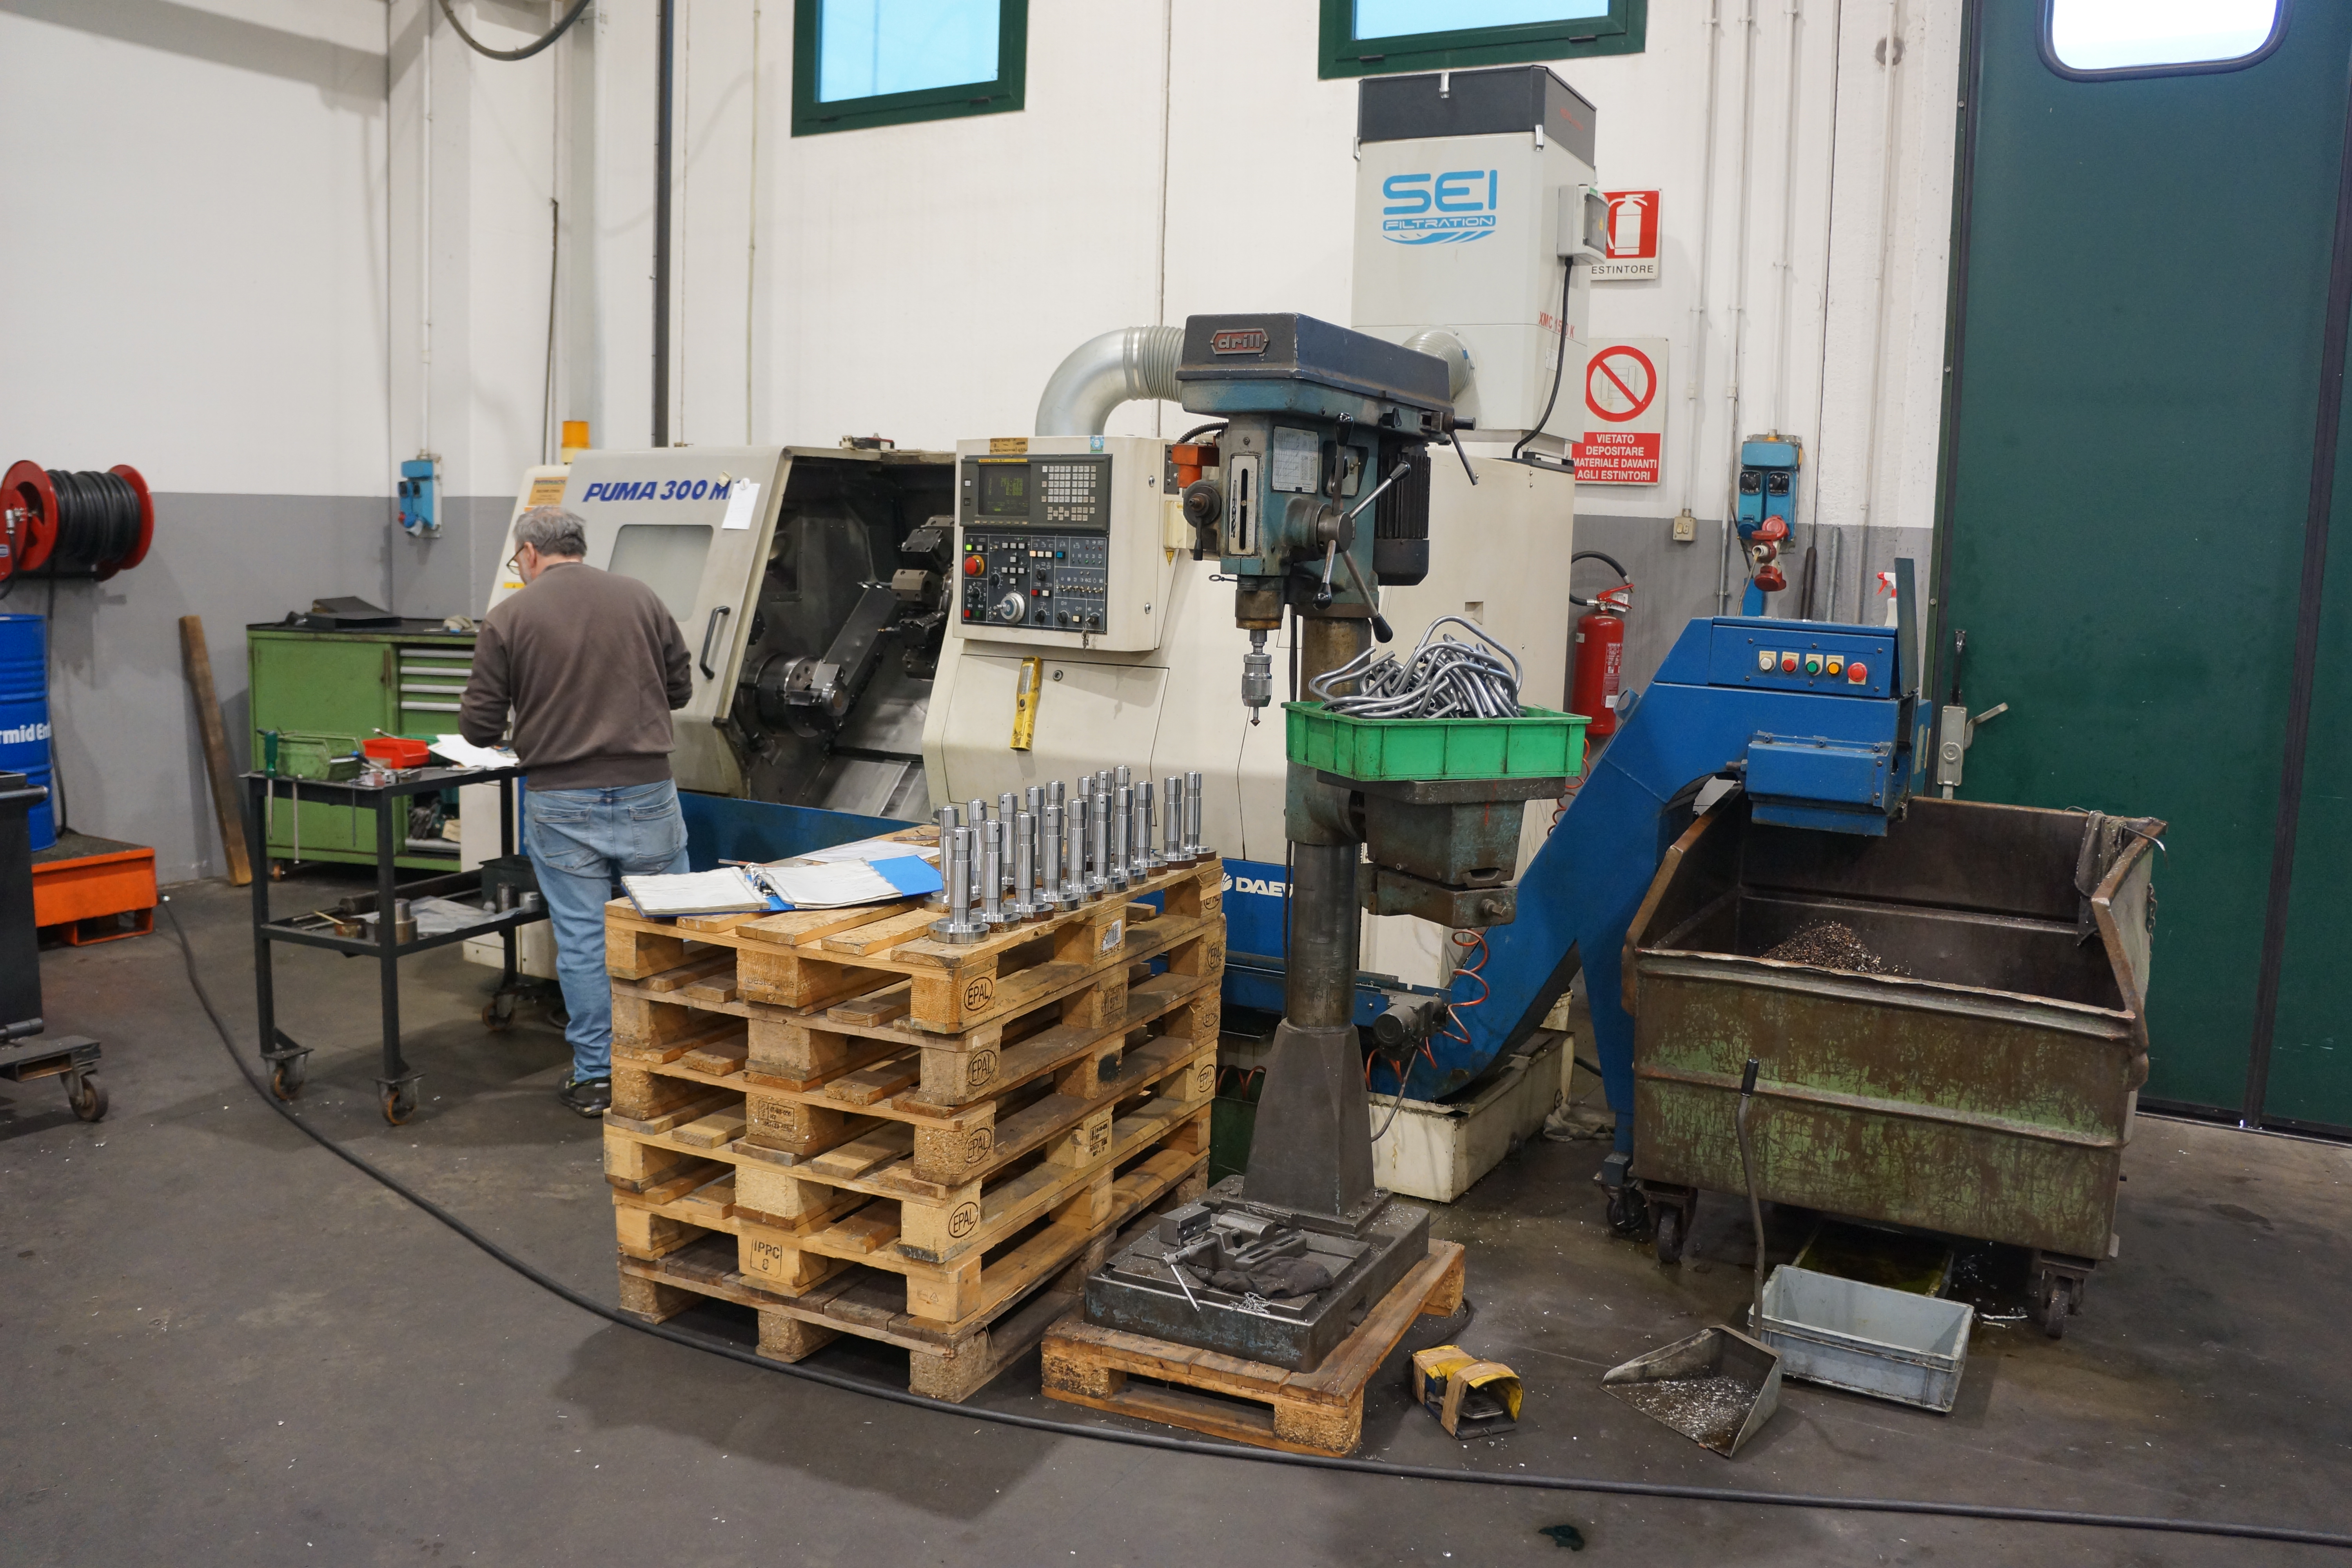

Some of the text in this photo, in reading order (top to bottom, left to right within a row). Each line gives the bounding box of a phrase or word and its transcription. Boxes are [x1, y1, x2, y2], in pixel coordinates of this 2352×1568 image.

[1383, 170, 1497, 215] SEI
[1385, 216, 1494, 230] FILTRATION
[1592, 265, 1653, 274] ESTINTORE
[1539, 311, 1553, 329] XMC
[1570, 325, 1575, 338] K
[1218, 334, 1261, 348] drill
[1596, 434, 1634, 444] VIETATO
[1586, 446, 1644, 456] DEPOSITARE
[1573, 457, 1657, 468] MATERIALE DAVANTI
[1577, 470, 1650, 481] AGLI ESTINTORI
[581, 481, 658, 503] PUMA
[660, 480, 708, 501] 300
[1210, 946, 1222, 965] EPA
[968, 982, 989, 1006] EPAL
[972, 1054, 991, 1082] EPAL
[968, 1133, 988, 1158] EPAL
[953, 1208, 974, 1234] EPAL
[754, 1240, 780, 1259] IPPC
